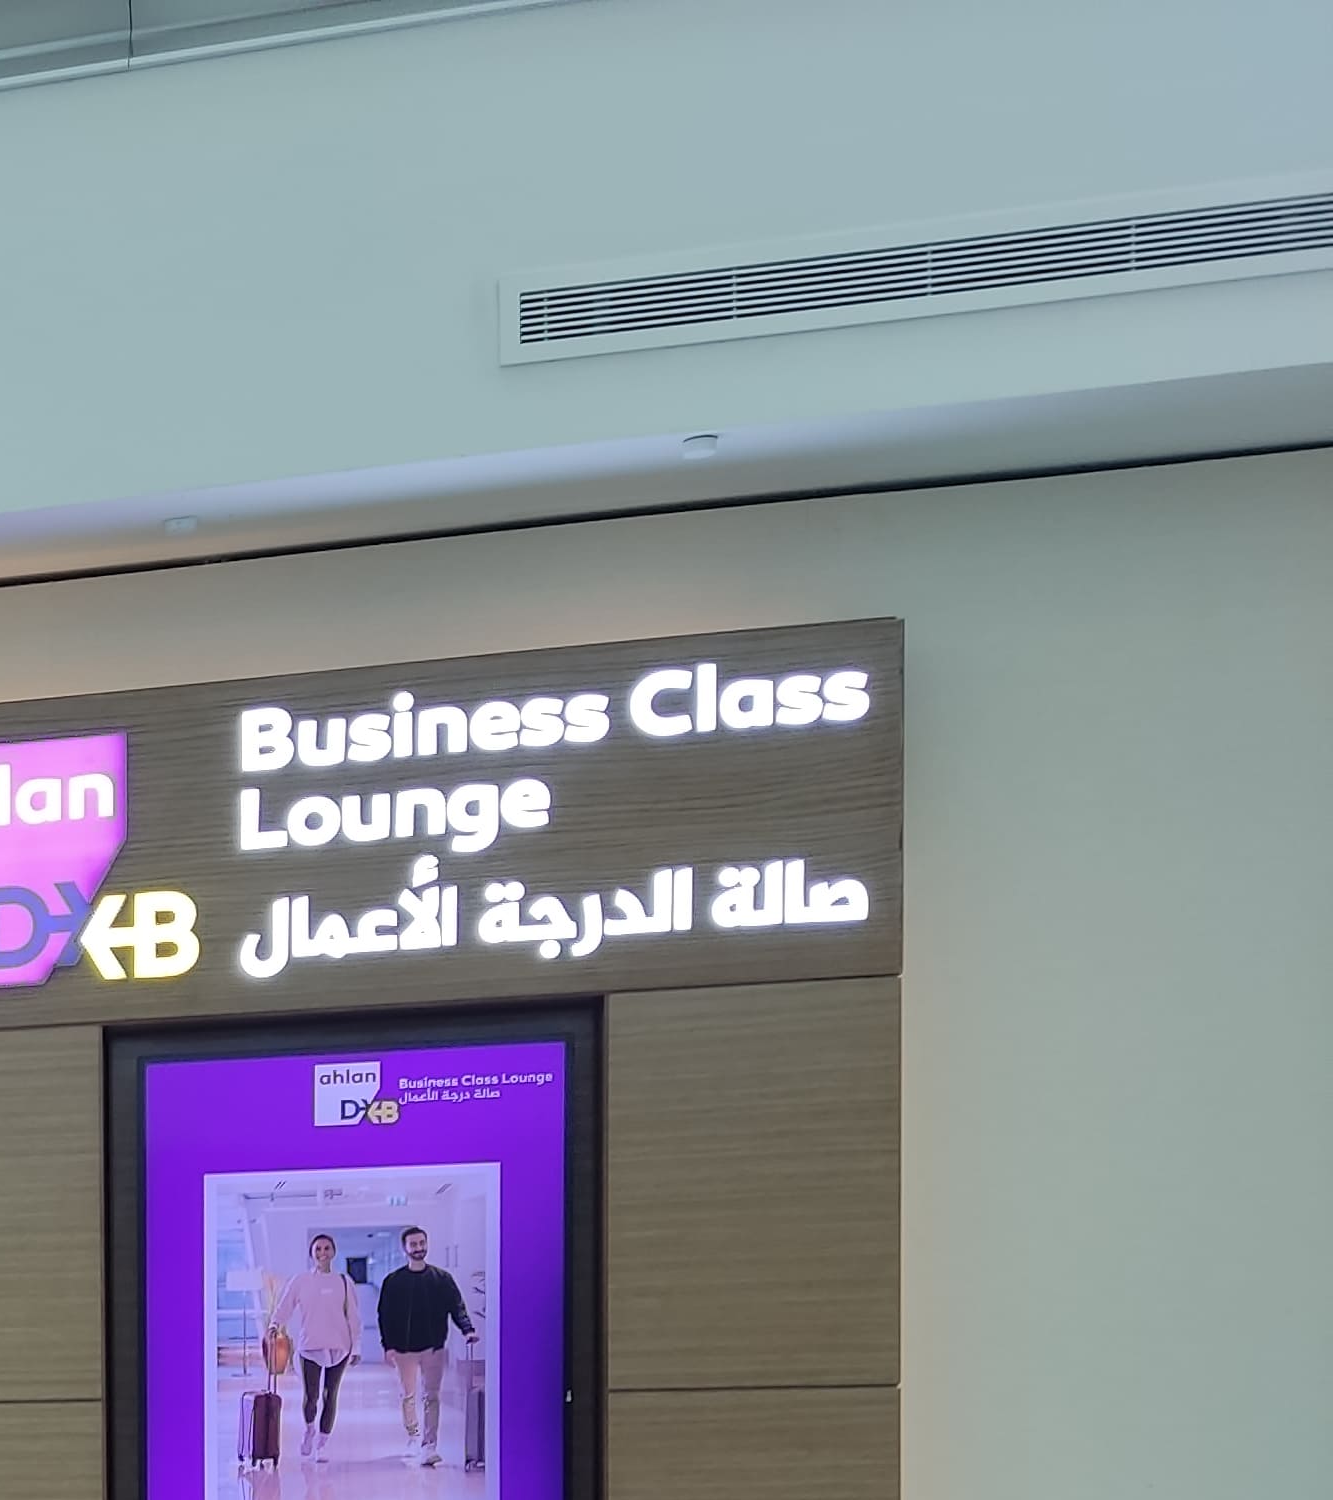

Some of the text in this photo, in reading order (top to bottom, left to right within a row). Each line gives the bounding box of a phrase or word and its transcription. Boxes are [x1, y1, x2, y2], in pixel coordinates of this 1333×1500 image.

[236, 661, 871, 775] Business Class
[236, 776, 552, 854] Lounge
[237, 854, 871, 979] صالة الدرجة الأعمال
[319, 1069, 377, 1086] ahlan
[399, 1073, 553, 1089] Business Class Lounge
